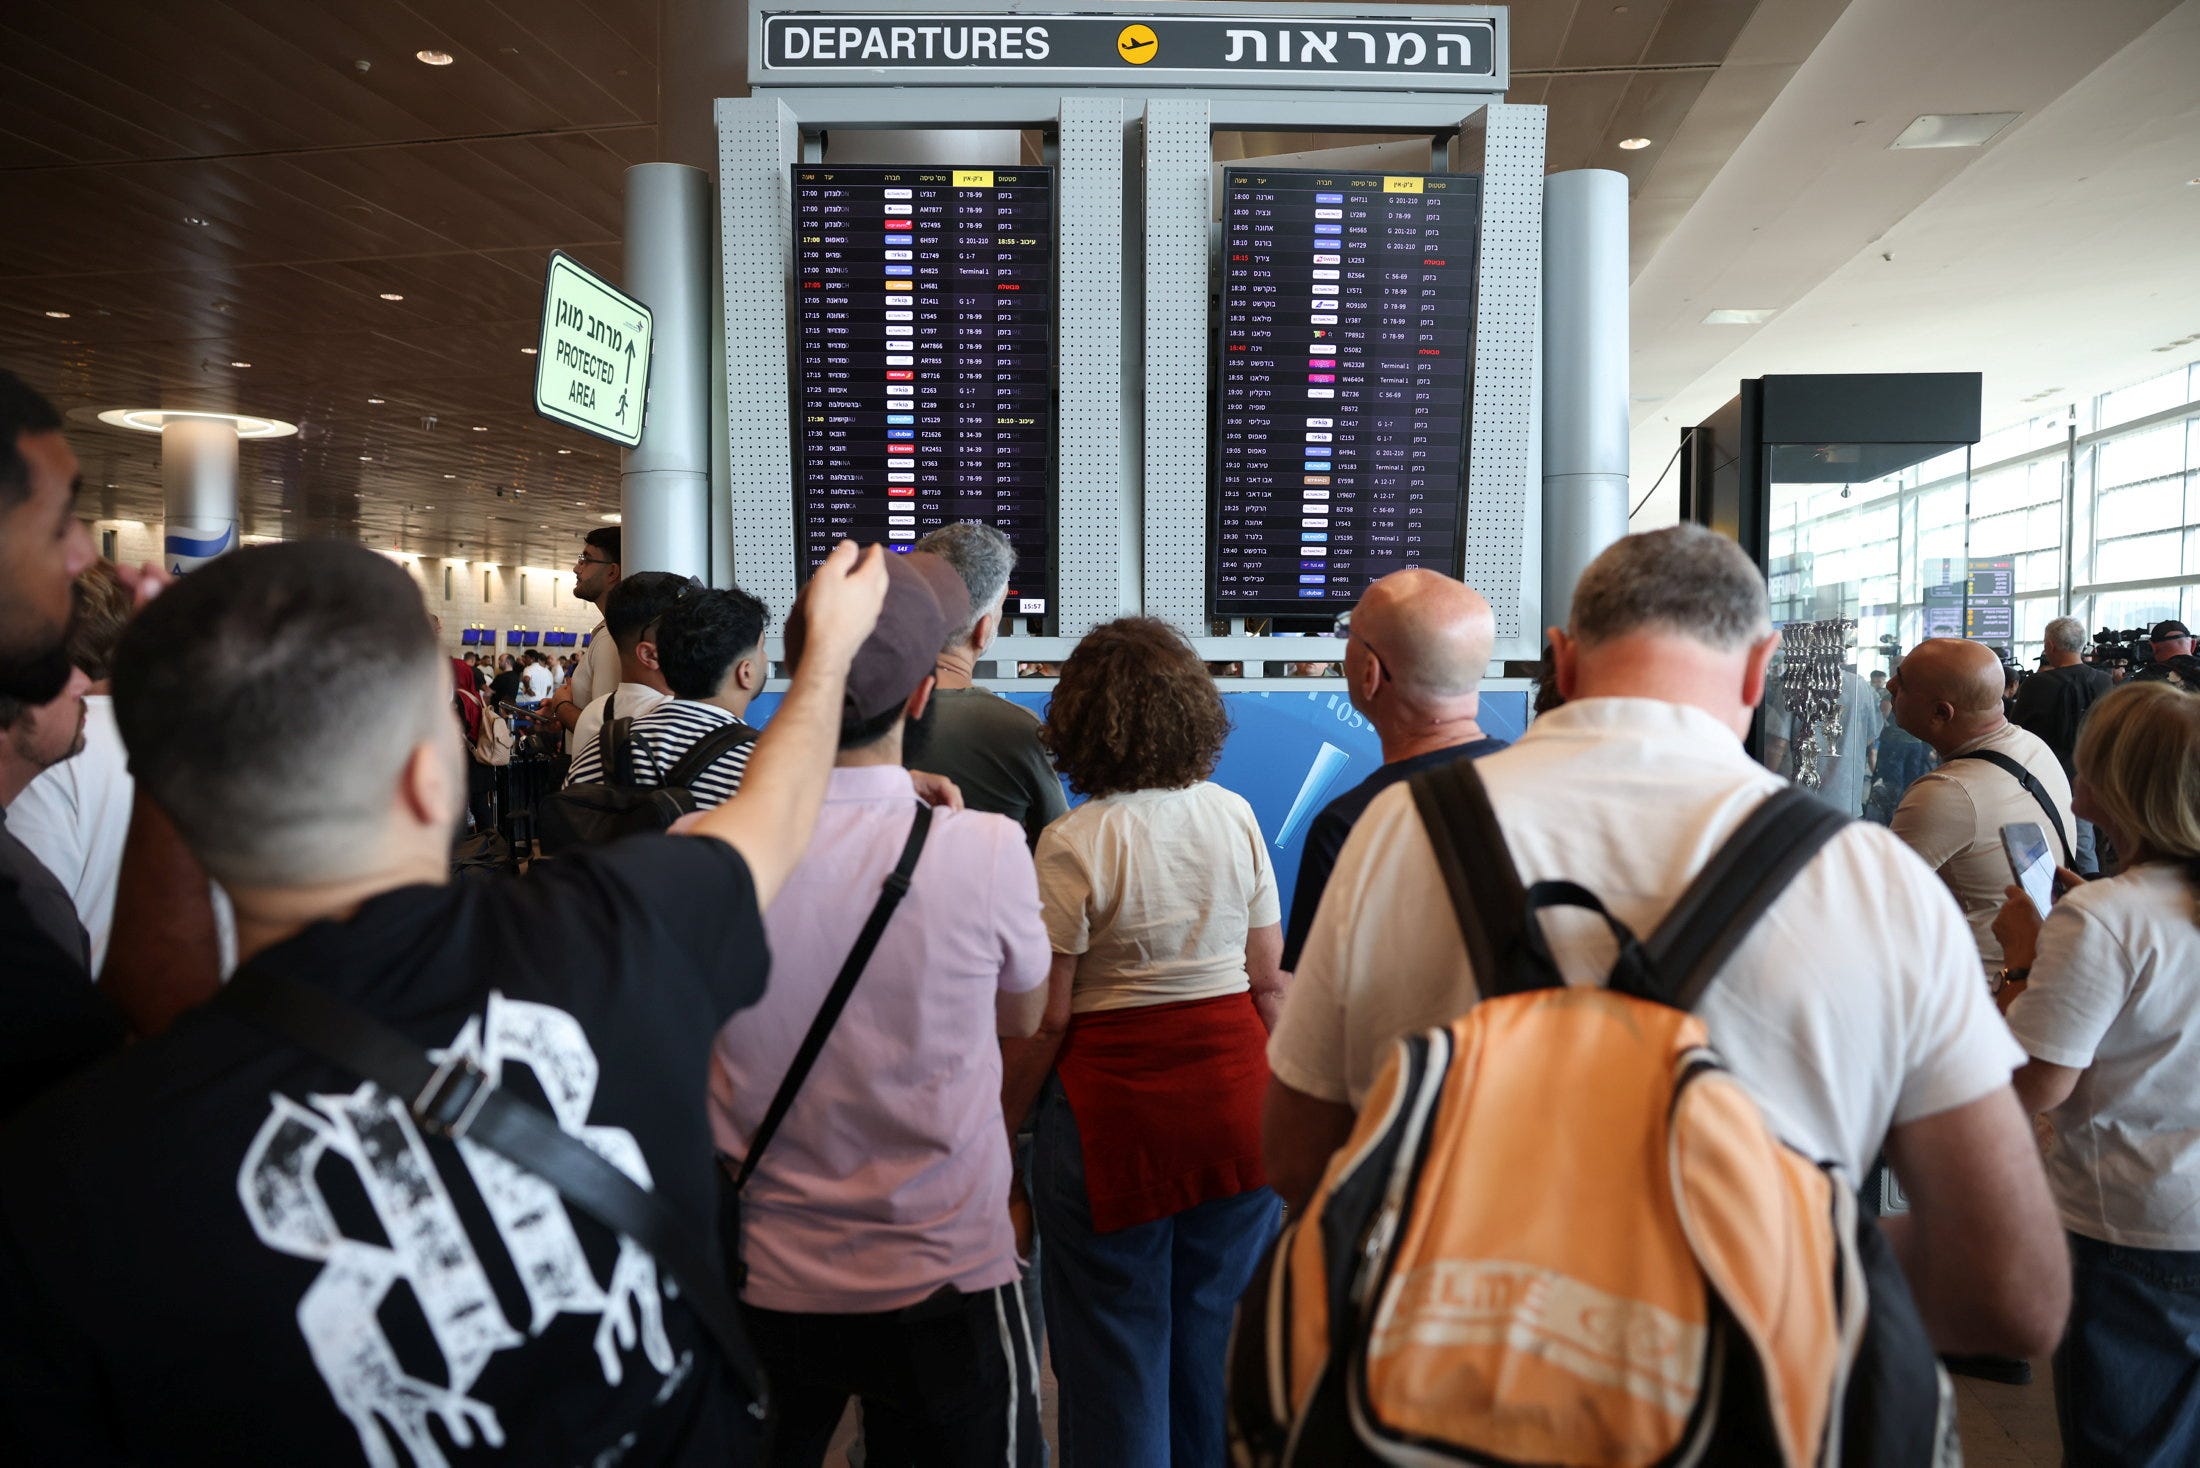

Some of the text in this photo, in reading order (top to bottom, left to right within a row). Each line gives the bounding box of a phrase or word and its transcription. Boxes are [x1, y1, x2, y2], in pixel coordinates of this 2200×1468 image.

[784, 27, 1050, 60] DEPARTURES
[1225, 29, 1472, 66] המראות
[998, 192, 1013, 200] בזמן
[997, 208, 1013, 216] בזמן
[997, 223, 1012, 231] בזמן
[997, 253, 1012, 261] בזמן
[1254, 255, 1270, 263] ציריך
[997, 268, 1013, 277] בזמן
[1252, 285, 1277, 294] בוקרשט
[997, 299, 1013, 307] בזמן
[1252, 300, 1276, 309] בוקרשט
[997, 314, 1012, 322] בזמן
[555, 297, 623, 352] מרחב מוגן
[997, 329, 1013, 337] בזמן
[556, 338, 615, 386] PROTECTED
[1417, 363, 1431, 371] בזמן
[568, 379, 596, 411] AREA
[1249, 389, 1271, 398] הרקליון
[1245, 505, 1267, 513] הרקליון
[1243, 561, 1262, 570] לרנקה
[1802, 559, 1812, 606] VAT
